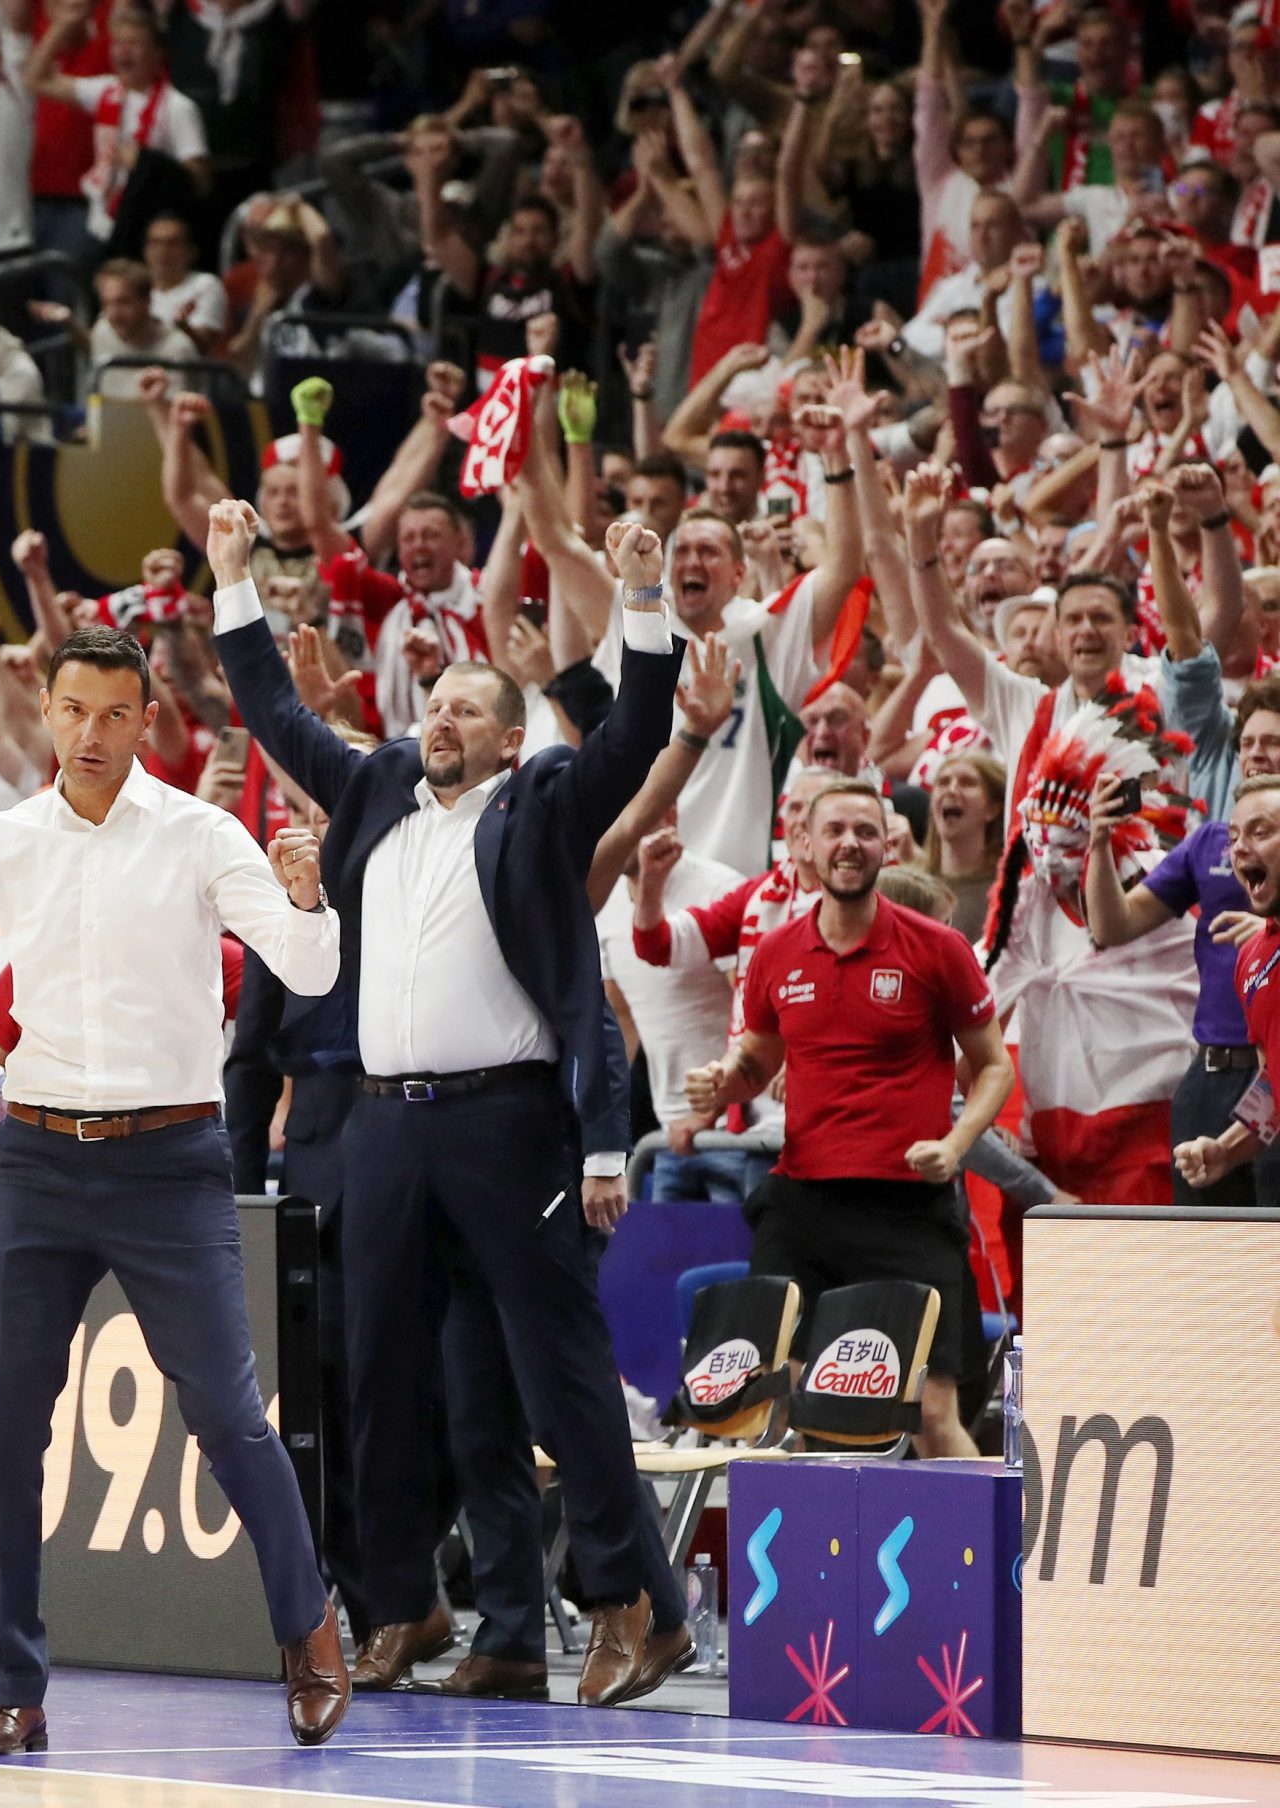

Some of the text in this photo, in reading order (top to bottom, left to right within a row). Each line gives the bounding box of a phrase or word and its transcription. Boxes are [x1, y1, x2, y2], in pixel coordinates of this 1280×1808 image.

[709, 1349, 754, 1374] 百岁山
[836, 1340, 890, 1362] 百岁山
